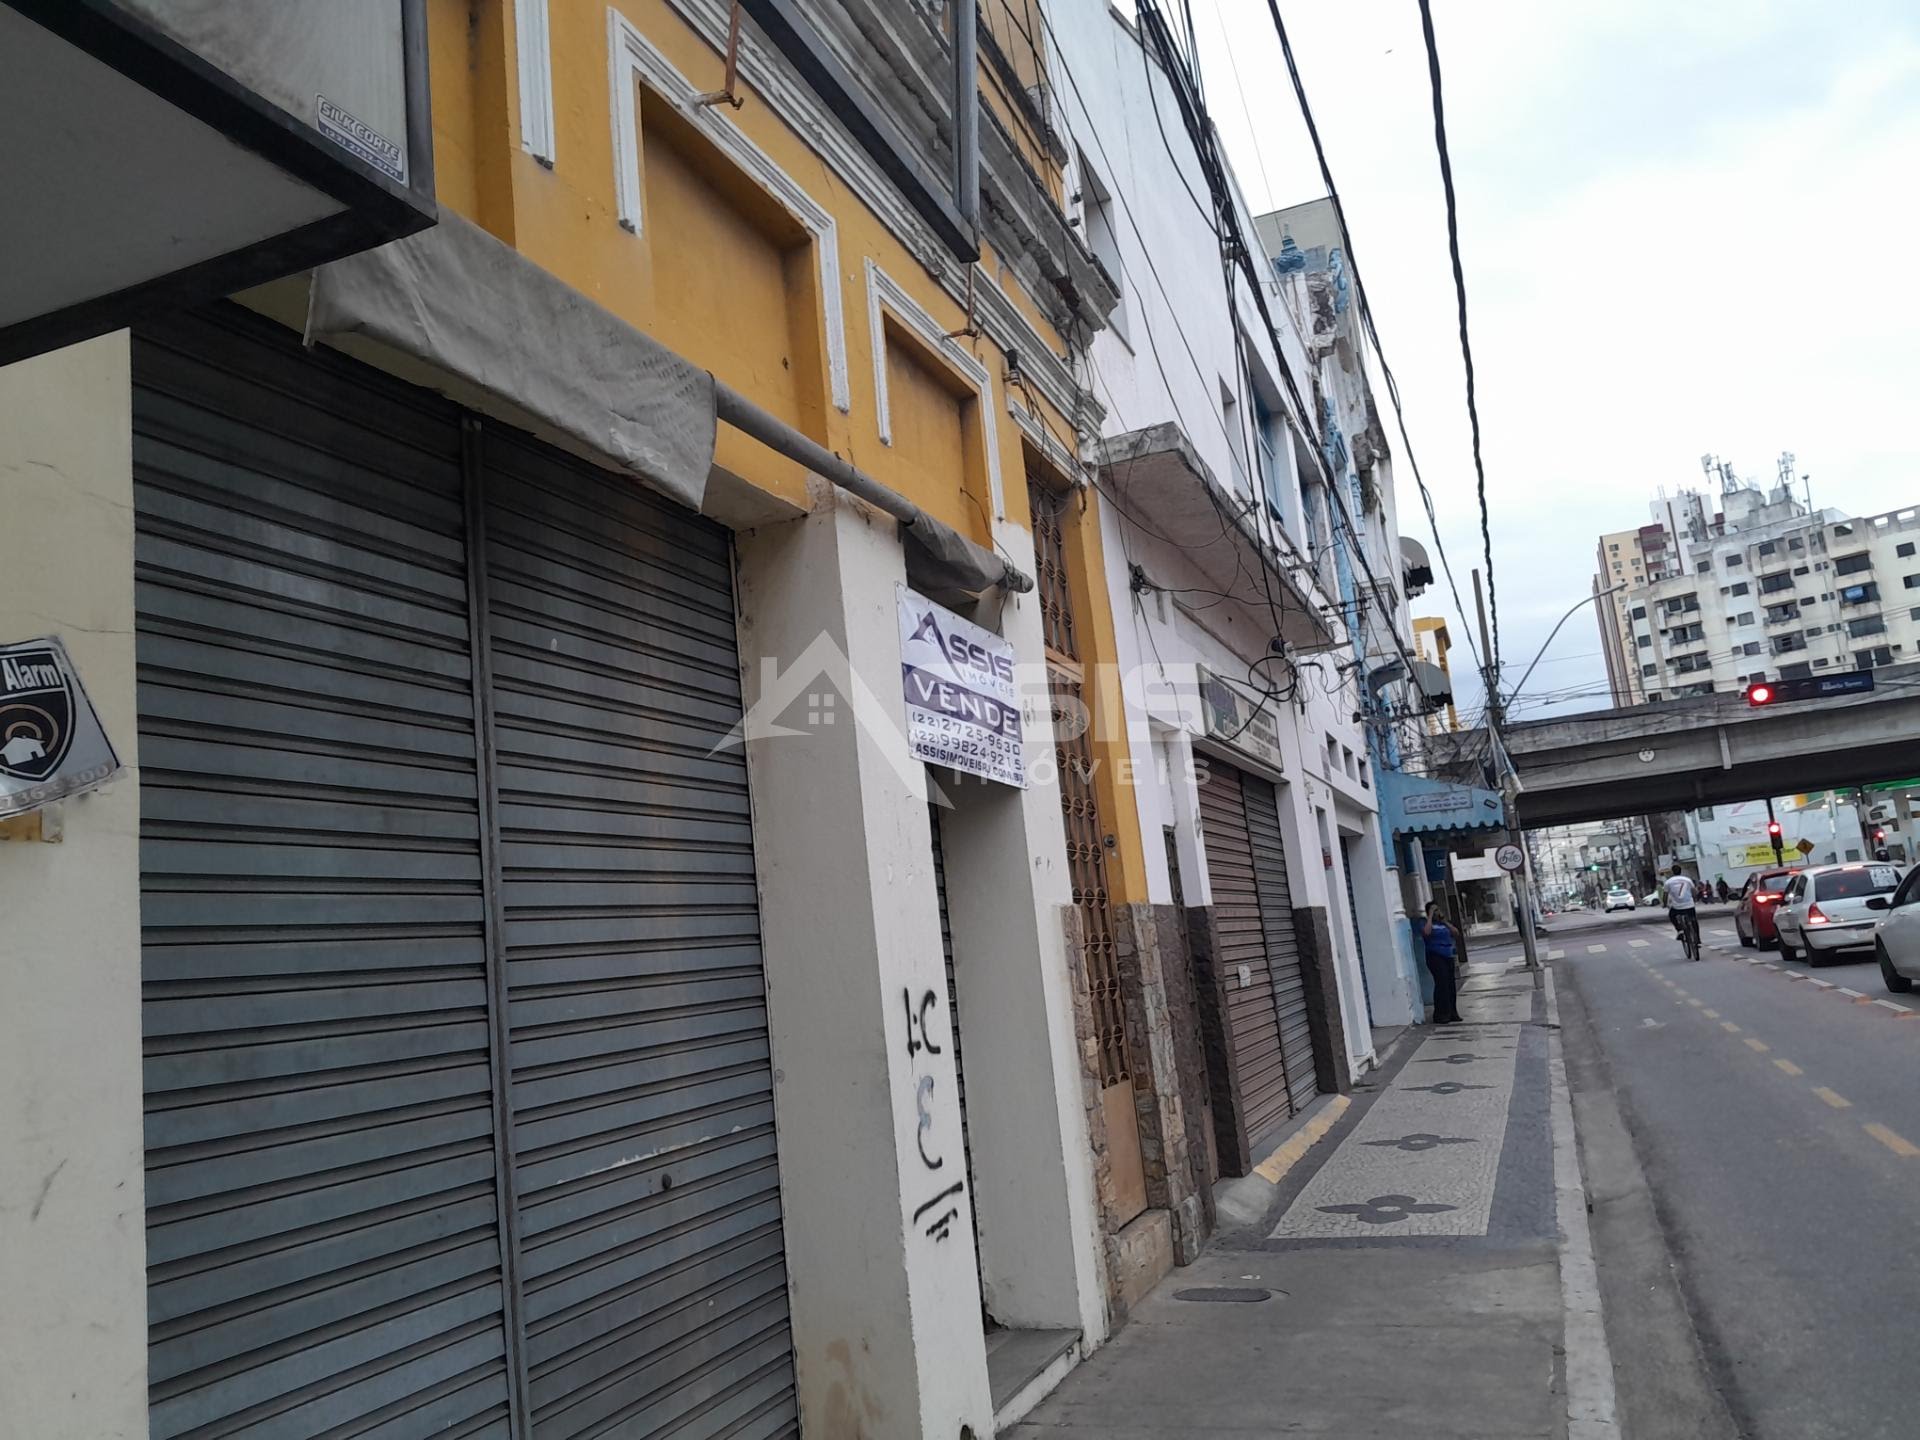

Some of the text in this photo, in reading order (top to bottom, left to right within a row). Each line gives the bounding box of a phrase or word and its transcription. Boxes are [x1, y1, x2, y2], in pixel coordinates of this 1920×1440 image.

[321, 102, 353, 133] SILK
[356, 123, 400, 161] CORTE
[1, 657, 60, 692] Alarm
[908, 610, 1015, 684] ASSIS
[912, 672, 1018, 735] VENDE
